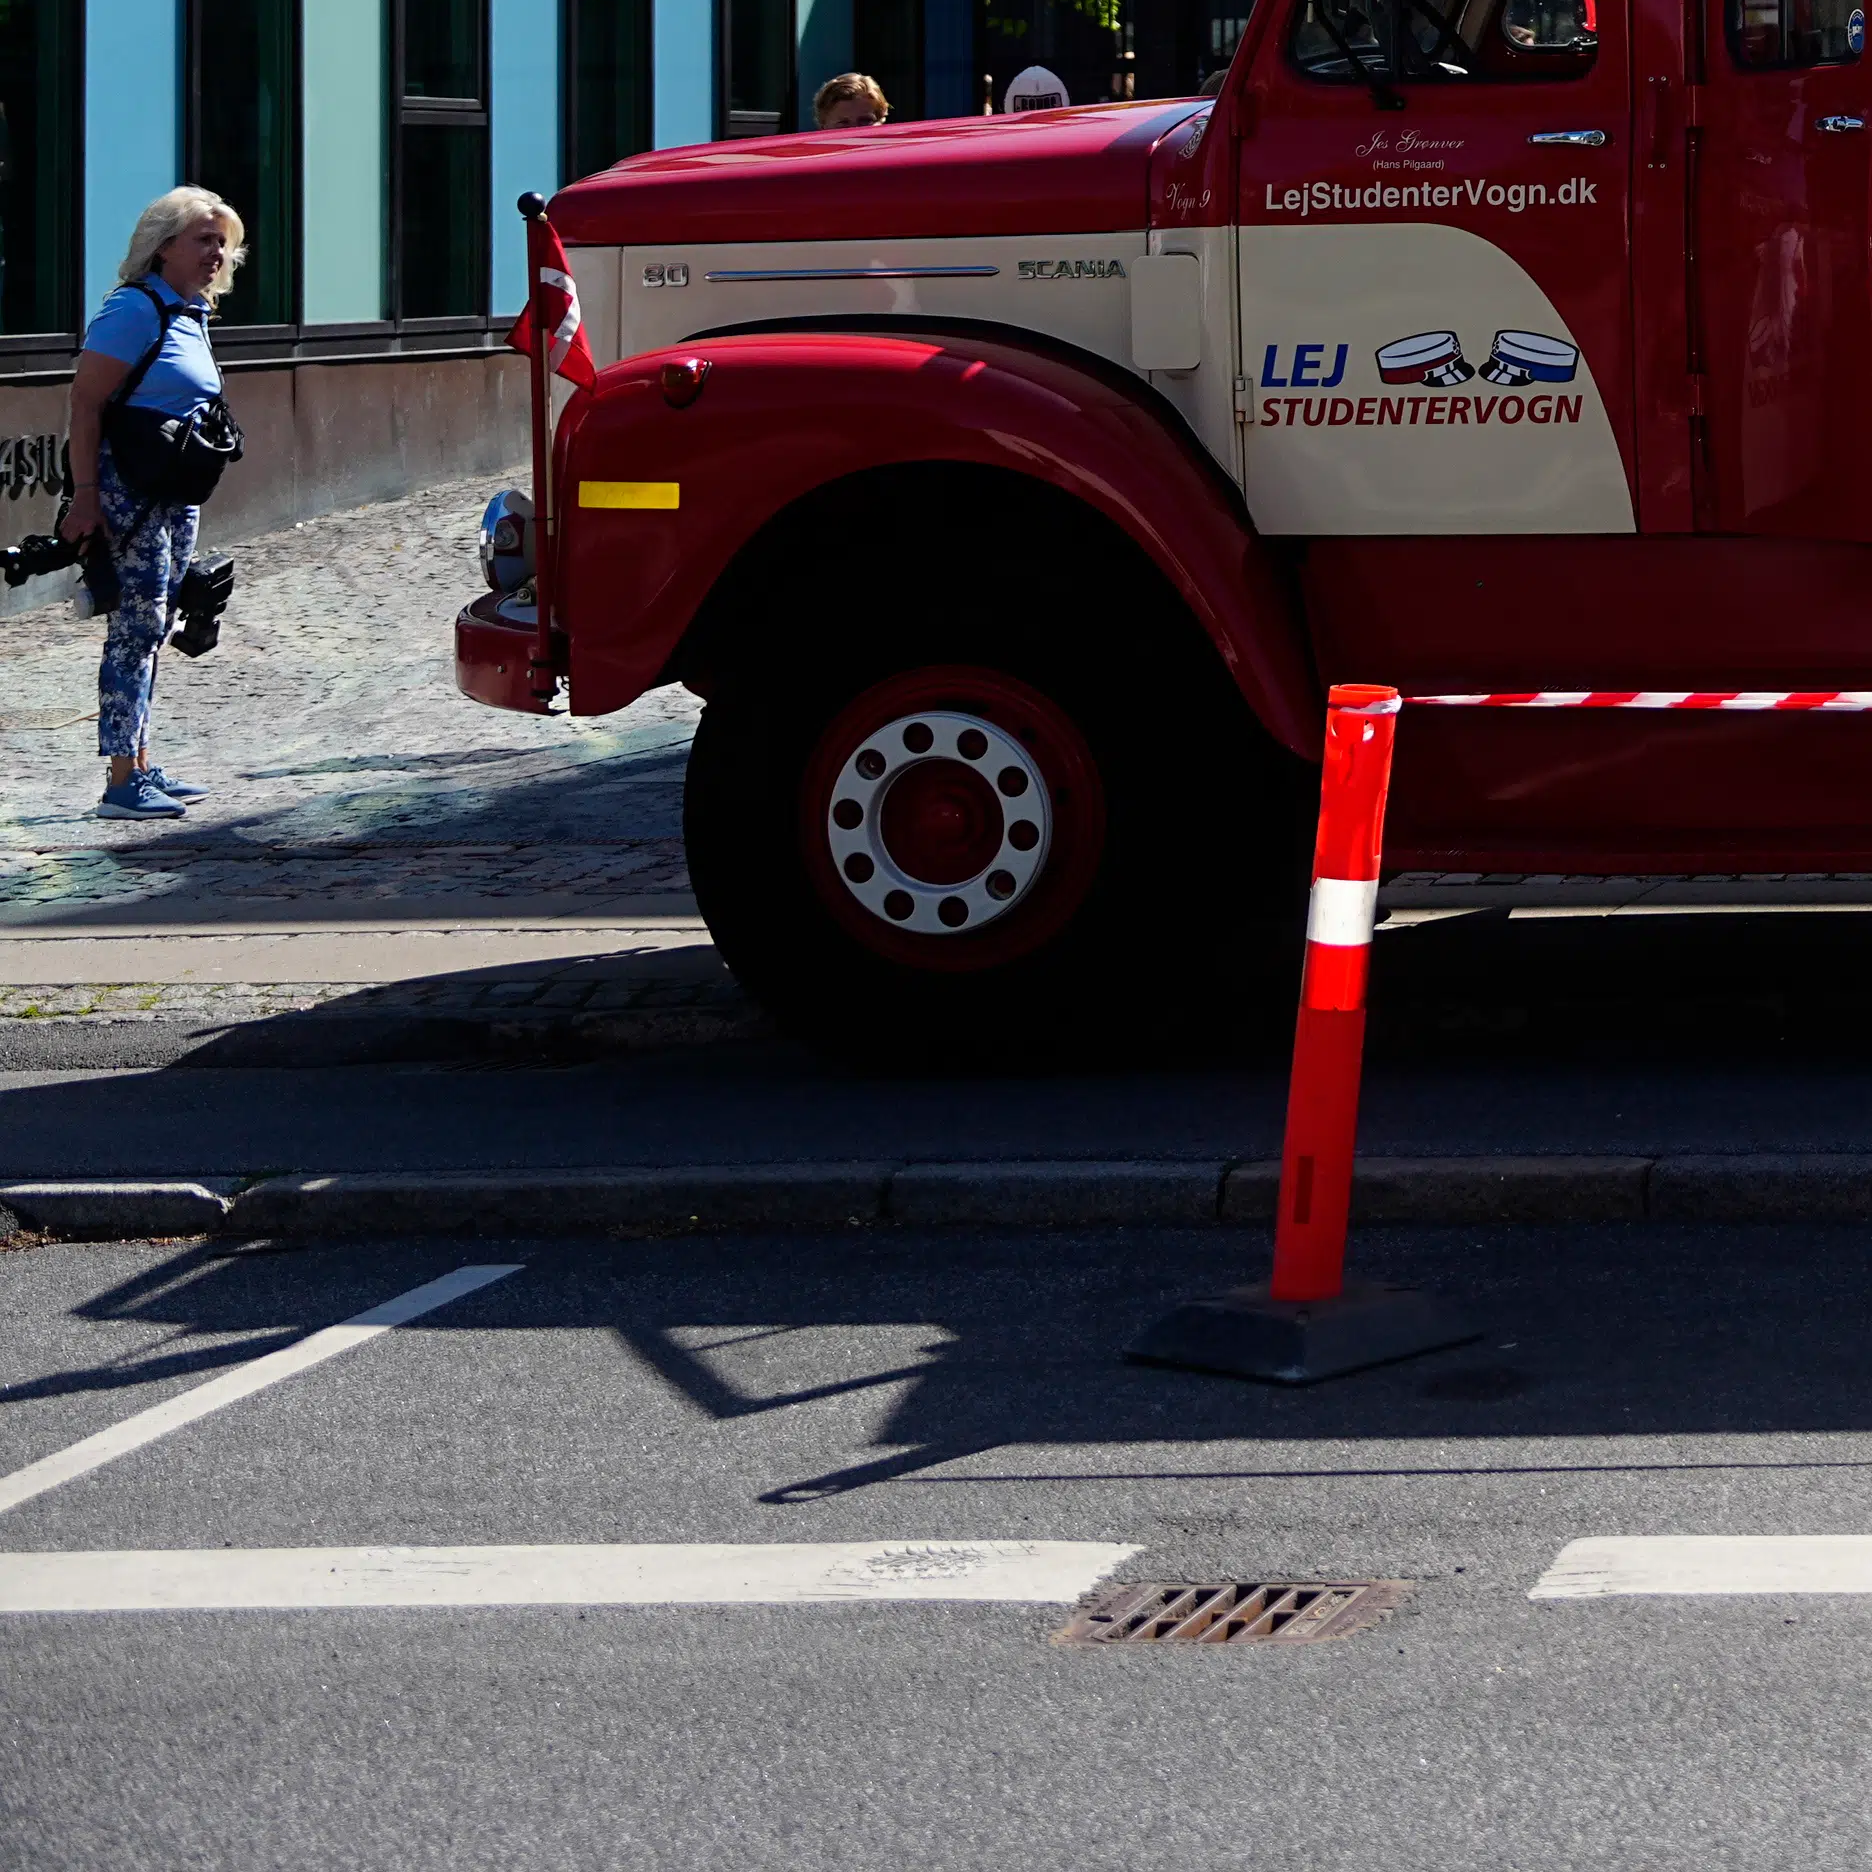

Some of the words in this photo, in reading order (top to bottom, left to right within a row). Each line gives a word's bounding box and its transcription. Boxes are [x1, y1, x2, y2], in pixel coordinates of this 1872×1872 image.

[1356, 130, 1388, 157] Jes
[1373, 160, 1401, 170] (Hans
[1403, 160, 1445, 171] Pilgaard)
[1166, 183, 1197, 220] Vogn
[1199, 189, 1211, 208] 9
[1265, 179, 1598, 215] LejStudenterVogn.dk
[643, 263, 689, 287] 80
[1017, 260, 1127, 280] SCANIA
[1260, 344, 1350, 387] LEJ
[1260, 395, 1583, 427] STUDENTERVOGN
